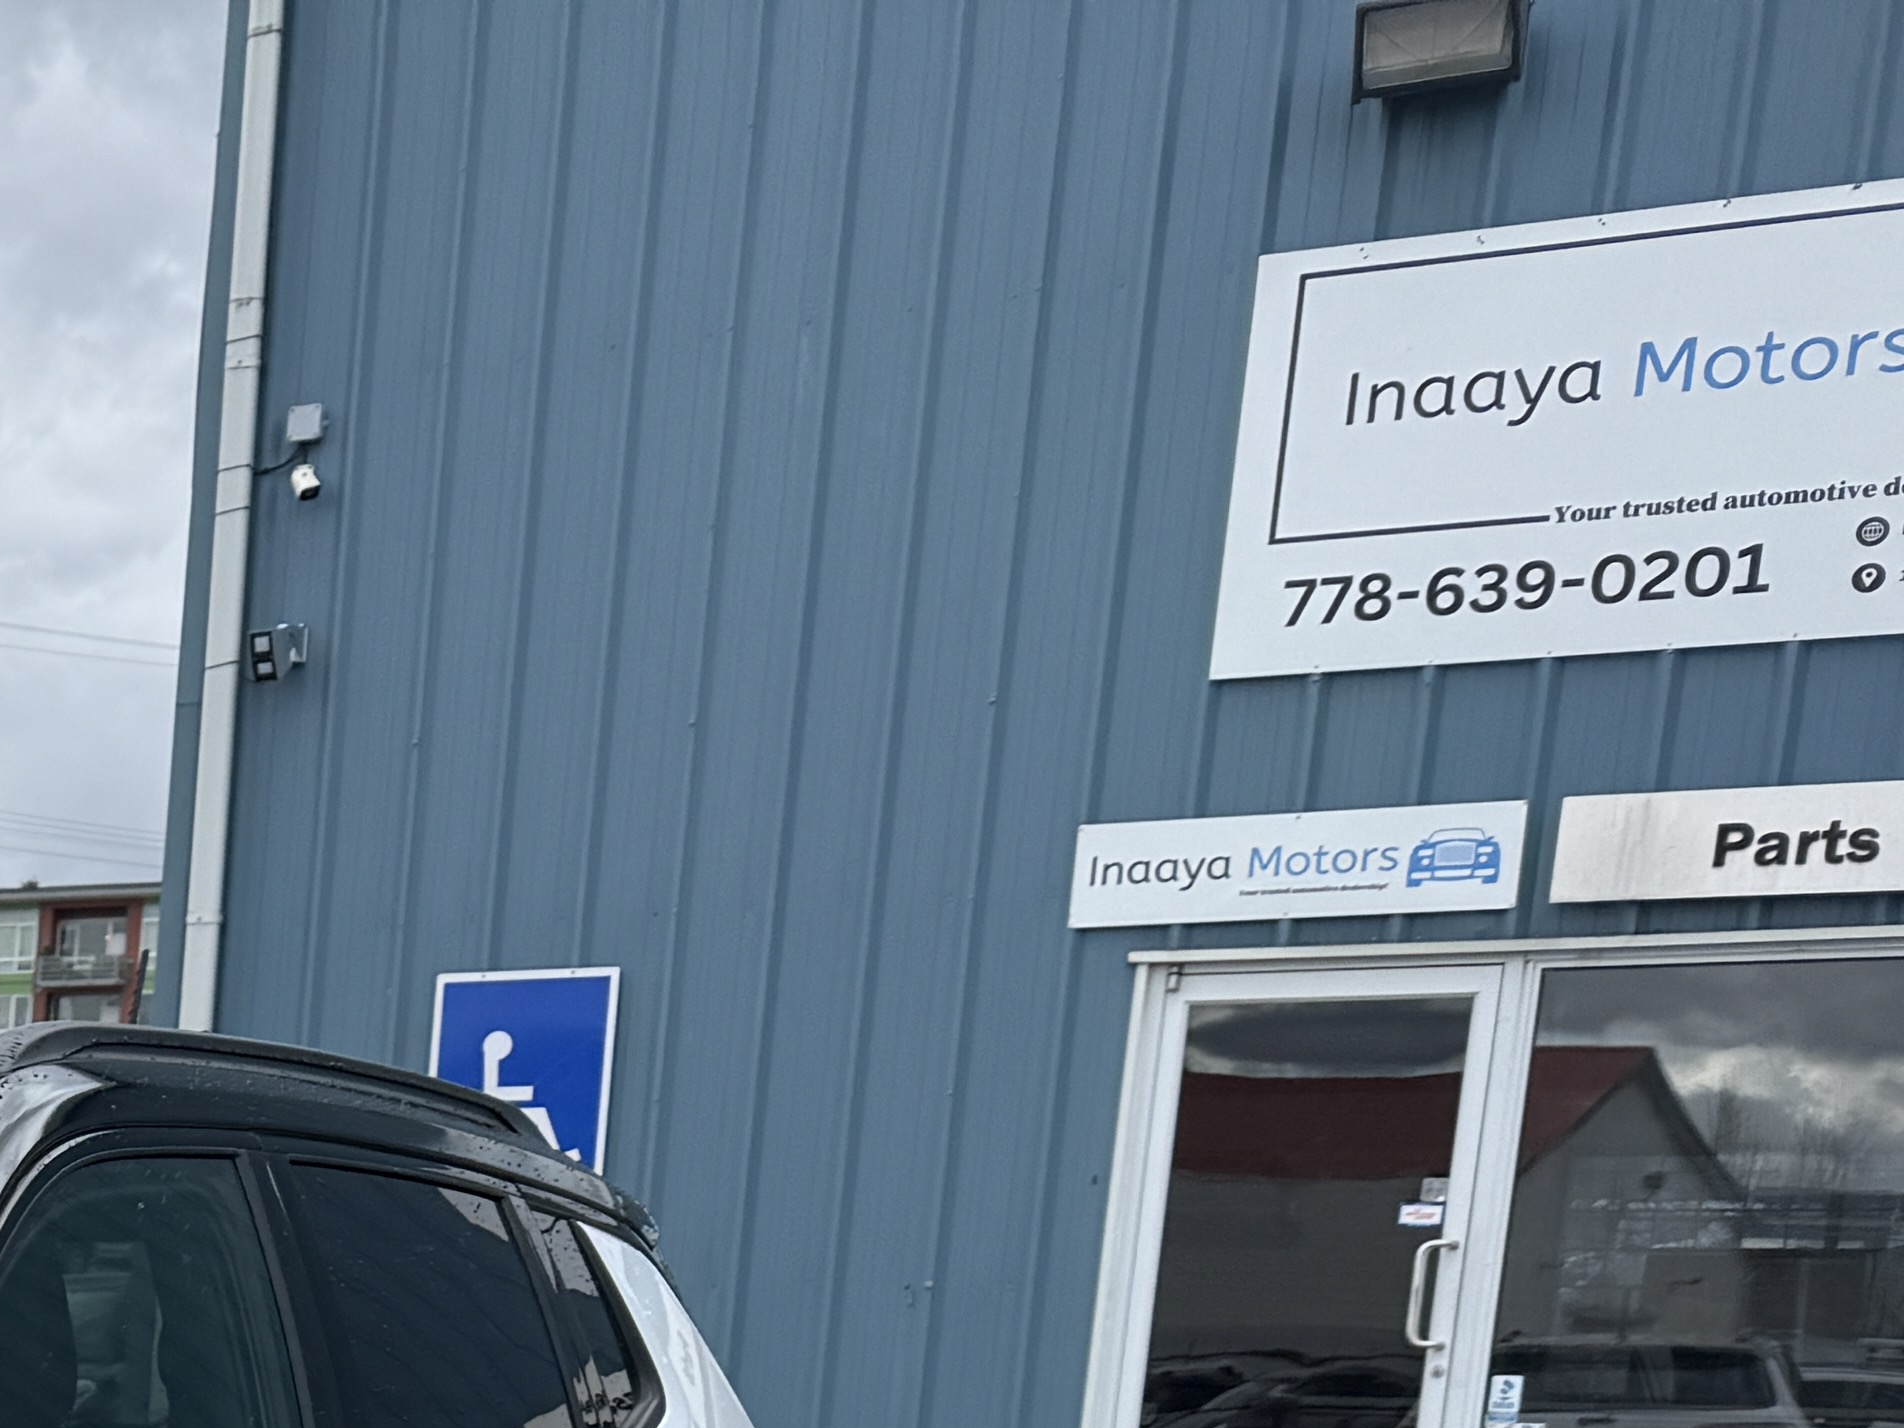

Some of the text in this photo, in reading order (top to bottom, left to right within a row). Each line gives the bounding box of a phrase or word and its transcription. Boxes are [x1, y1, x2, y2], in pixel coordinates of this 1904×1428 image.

[1344, 327, 1904, 427] Inaaya Motors
[1555, 506, 1617, 524] Your
[1622, 492, 1718, 519] trusted
[1723, 480, 1879, 511] automotive
[1283, 543, 1771, 628] 778-639-0201
[1089, 844, 1400, 892] Inaaya Motors
[1711, 819, 1881, 868] Parts
